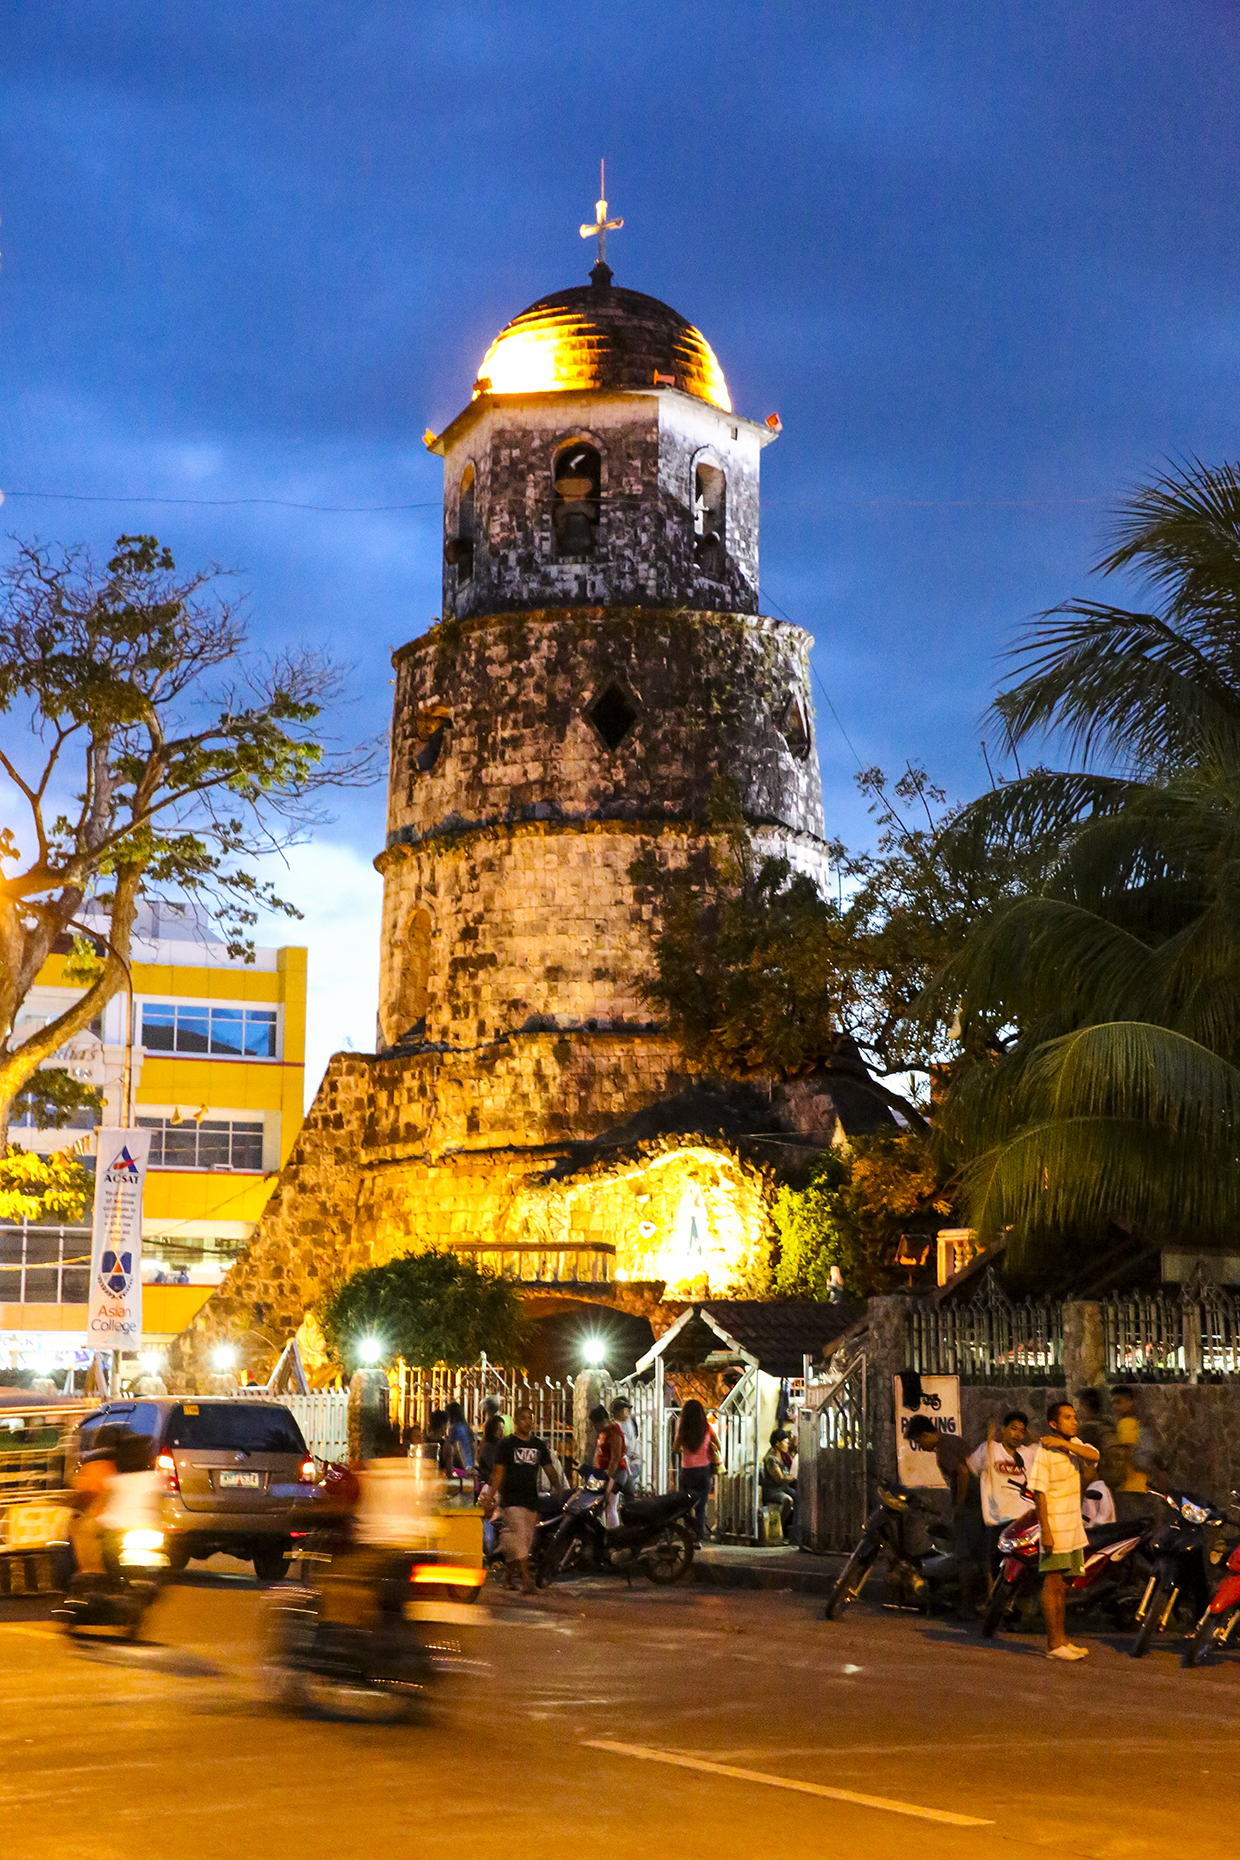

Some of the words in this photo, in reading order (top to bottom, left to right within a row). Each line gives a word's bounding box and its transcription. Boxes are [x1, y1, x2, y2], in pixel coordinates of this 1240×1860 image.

[104, 1174, 139, 1184] ACSAT
[98, 1305, 131, 1317] Asian
[91, 1319, 136, 1334] College
[901, 1416, 956, 1433] PING
